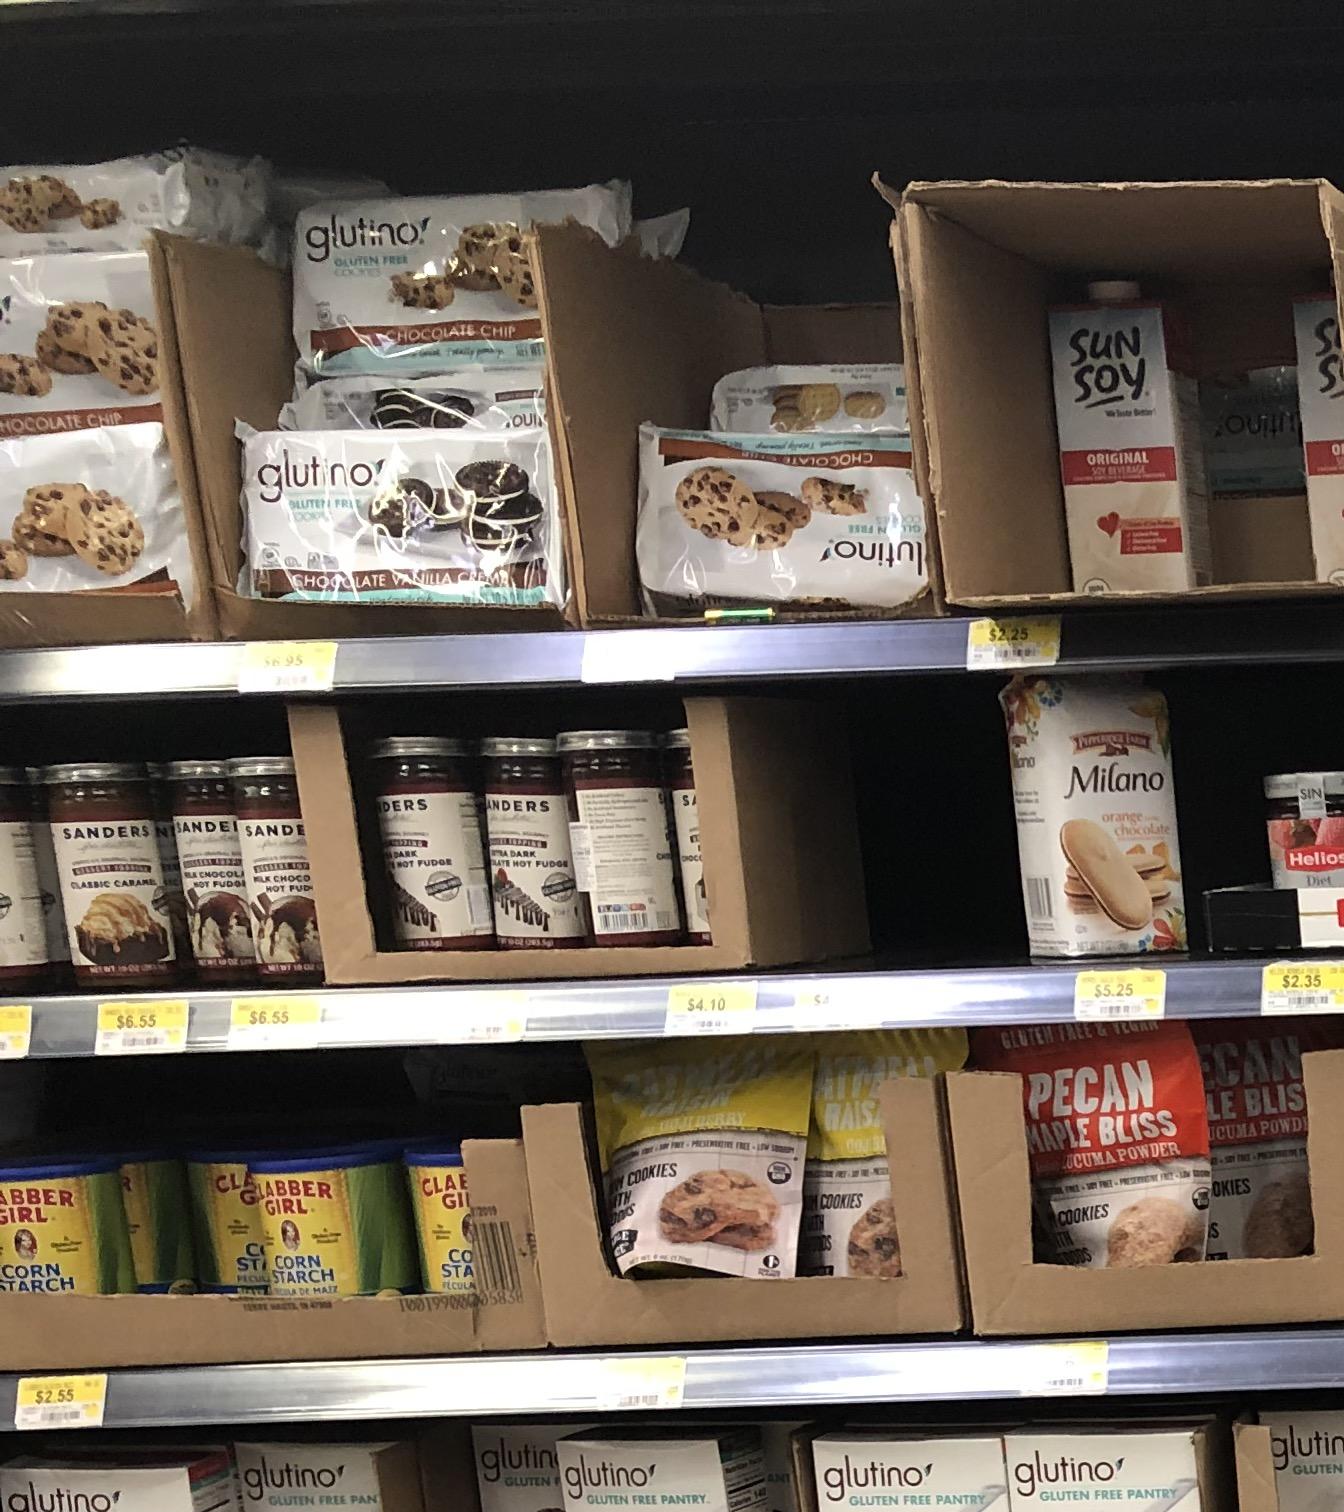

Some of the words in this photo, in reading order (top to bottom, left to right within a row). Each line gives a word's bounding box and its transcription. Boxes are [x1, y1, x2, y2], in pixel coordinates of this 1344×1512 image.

[305, 216, 416, 261] glutino
[384, 325, 479, 342] CHOCOLATE
[482, 324, 517, 340] CHIP
[1069, 326, 1141, 361] SUN
[1075, 358, 1147, 401] SOY
[1086, 450, 1149, 466] ORIGINAL
[292, 571, 386, 589] CHOCOLATE
[392, 571, 451, 588] VANILLA
[988, 627, 1029, 642] $2.25
[1064, 764, 1165, 801] Milano
[1300, 788, 1322, 801] SIN
[62, 824, 150, 840] SANDERS
[1114, 821, 1170, 838] chocolate
[513, 860, 532, 868] HOT
[536, 860, 568, 868] FUDGE
[70, 879, 114, 891] CLASSIC
[1281, 973, 1322, 989] $2.35
[1094, 982, 1134, 998] $5.25
[116, 1012, 157, 1030] $6.55
[1028, 1059, 1154, 1119] PECAN
[265, 1199, 309, 1215] GIRL
[273, 1254, 321, 1272] CORN
[272, 1268, 335, 1286] STARCH
[34, 1388, 75, 1404] $2.55
[824, 1456, 923, 1501] glutino
